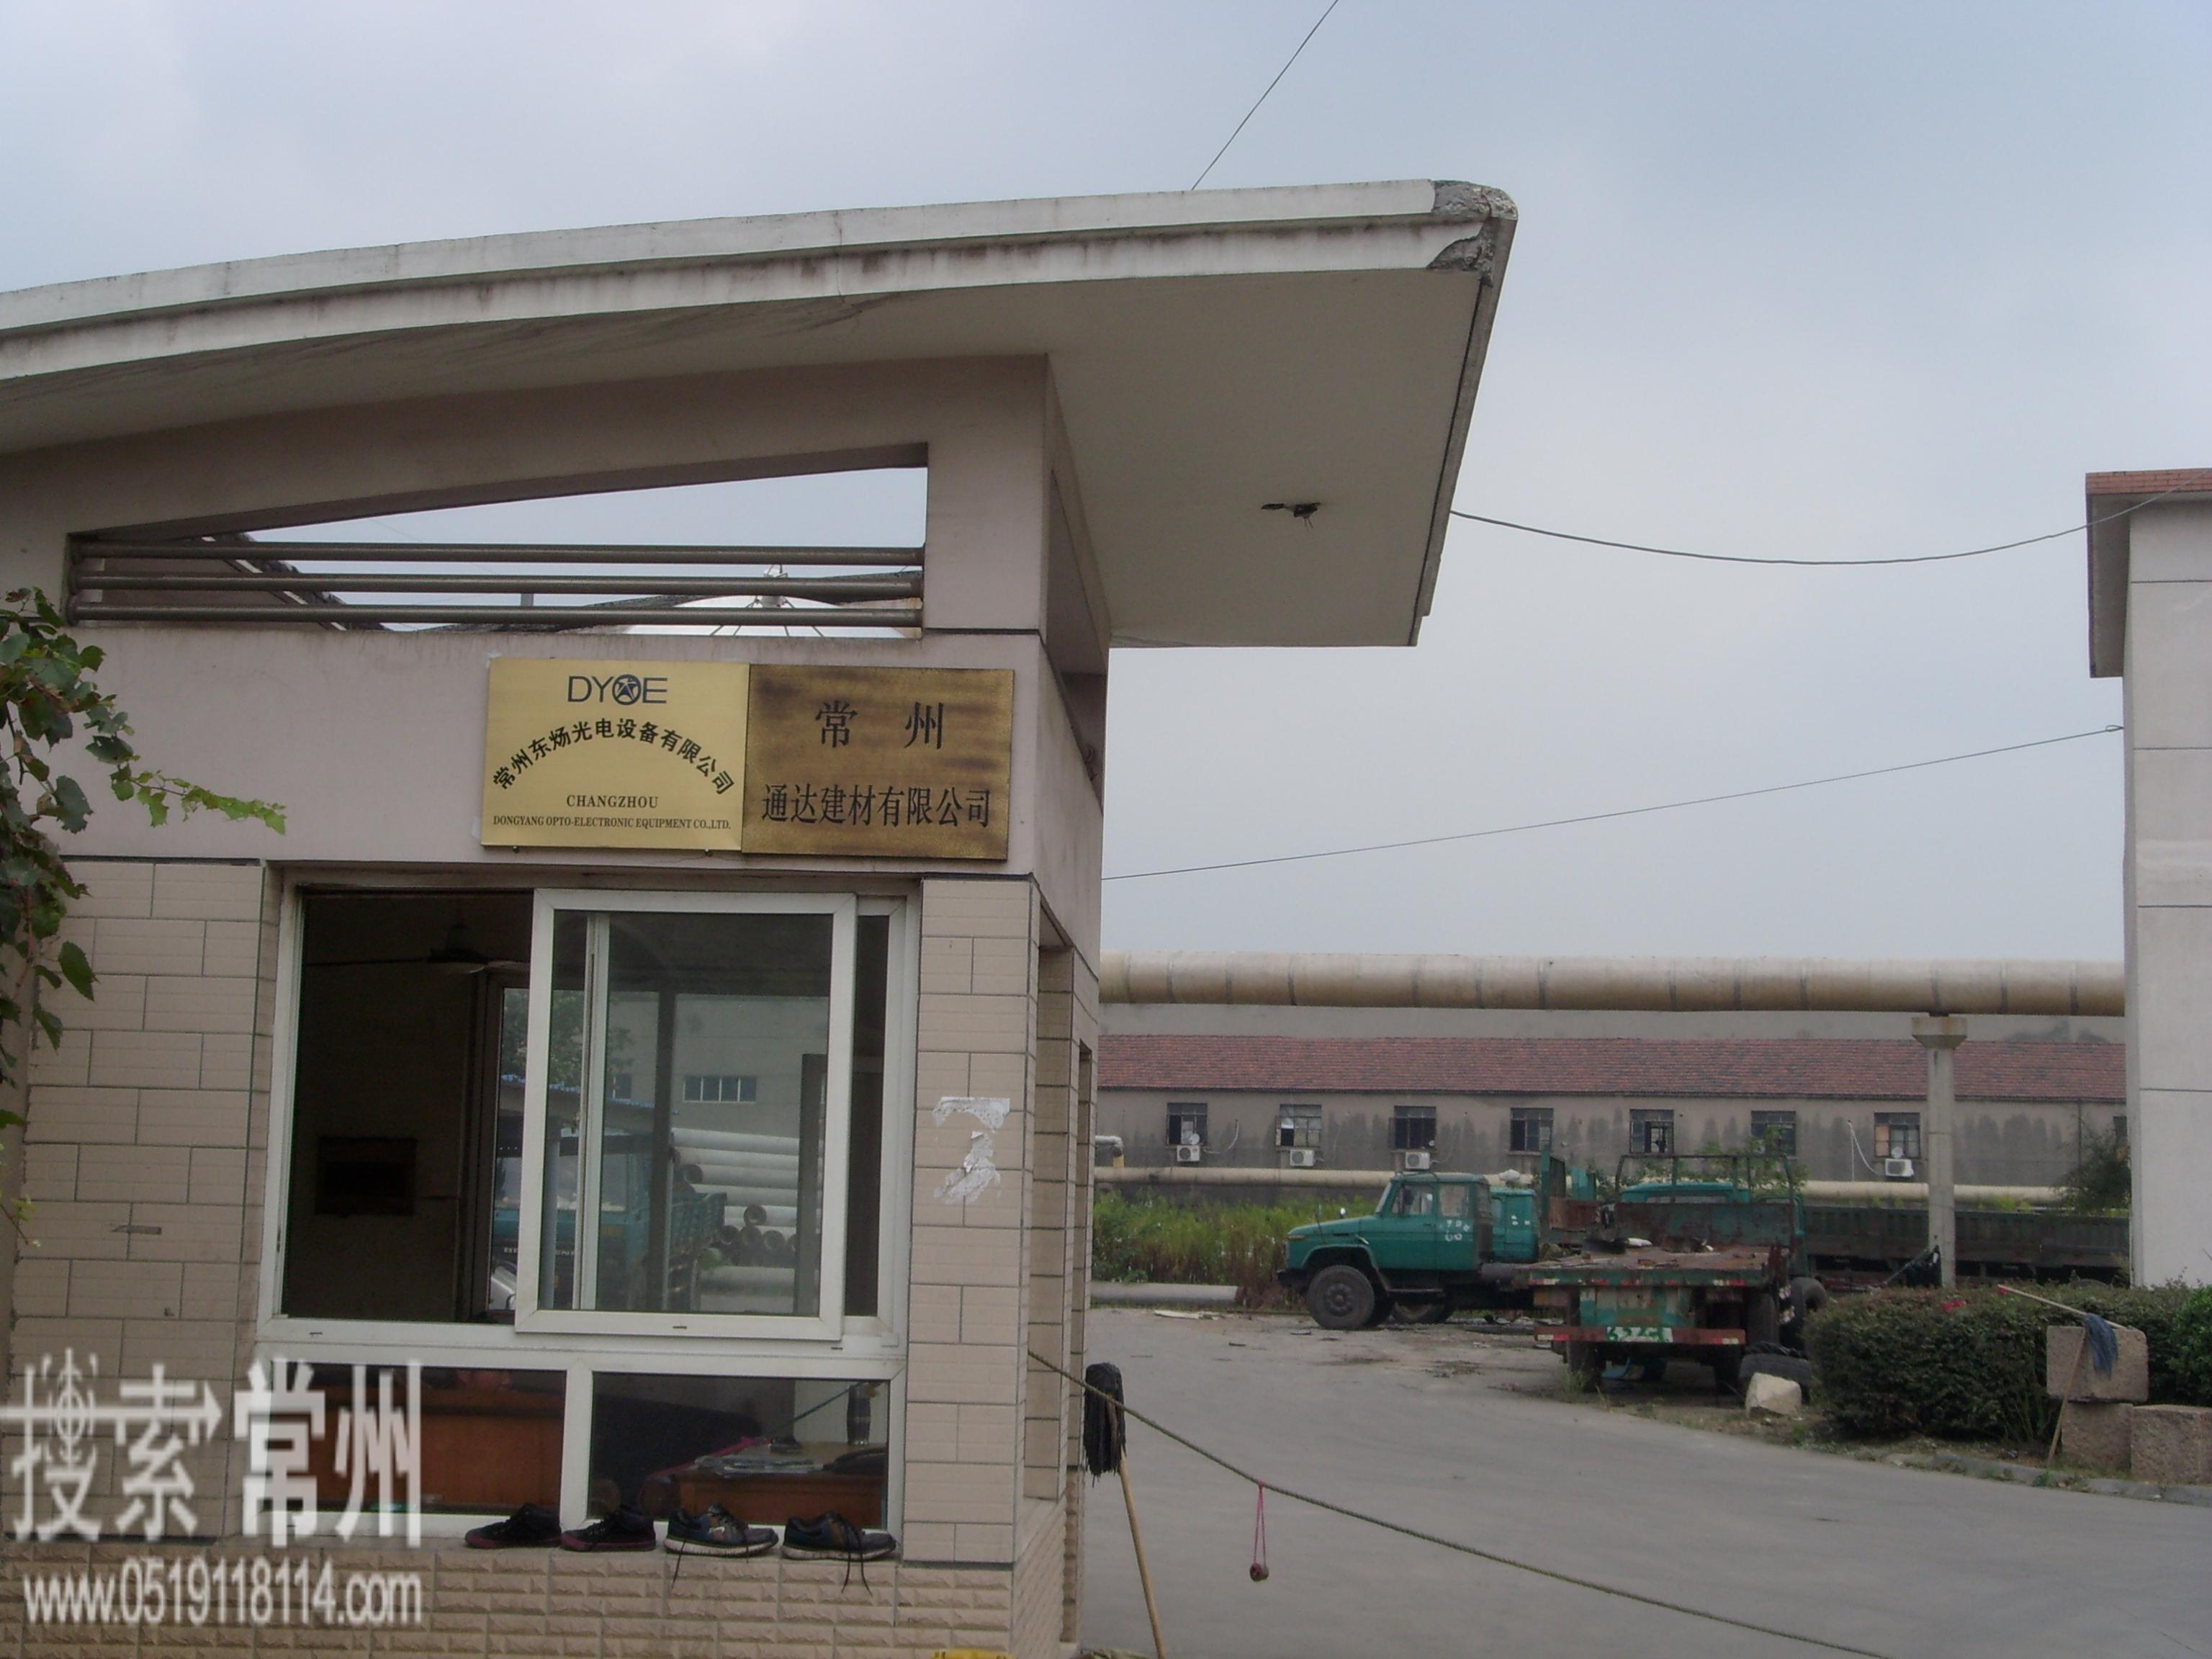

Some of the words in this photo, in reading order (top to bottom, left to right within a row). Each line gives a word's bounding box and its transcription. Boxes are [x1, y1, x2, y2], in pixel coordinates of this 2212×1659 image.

[566, 794, 659, 809] CHANGZHOU
[761, 783, 991, 828] 通达建材有限公司
[493, 815, 544, 826] DONGYANG
[546, 816, 634, 827] OPTO-ELECTRONIC
[635, 818, 692, 830] EQUIPMENT
